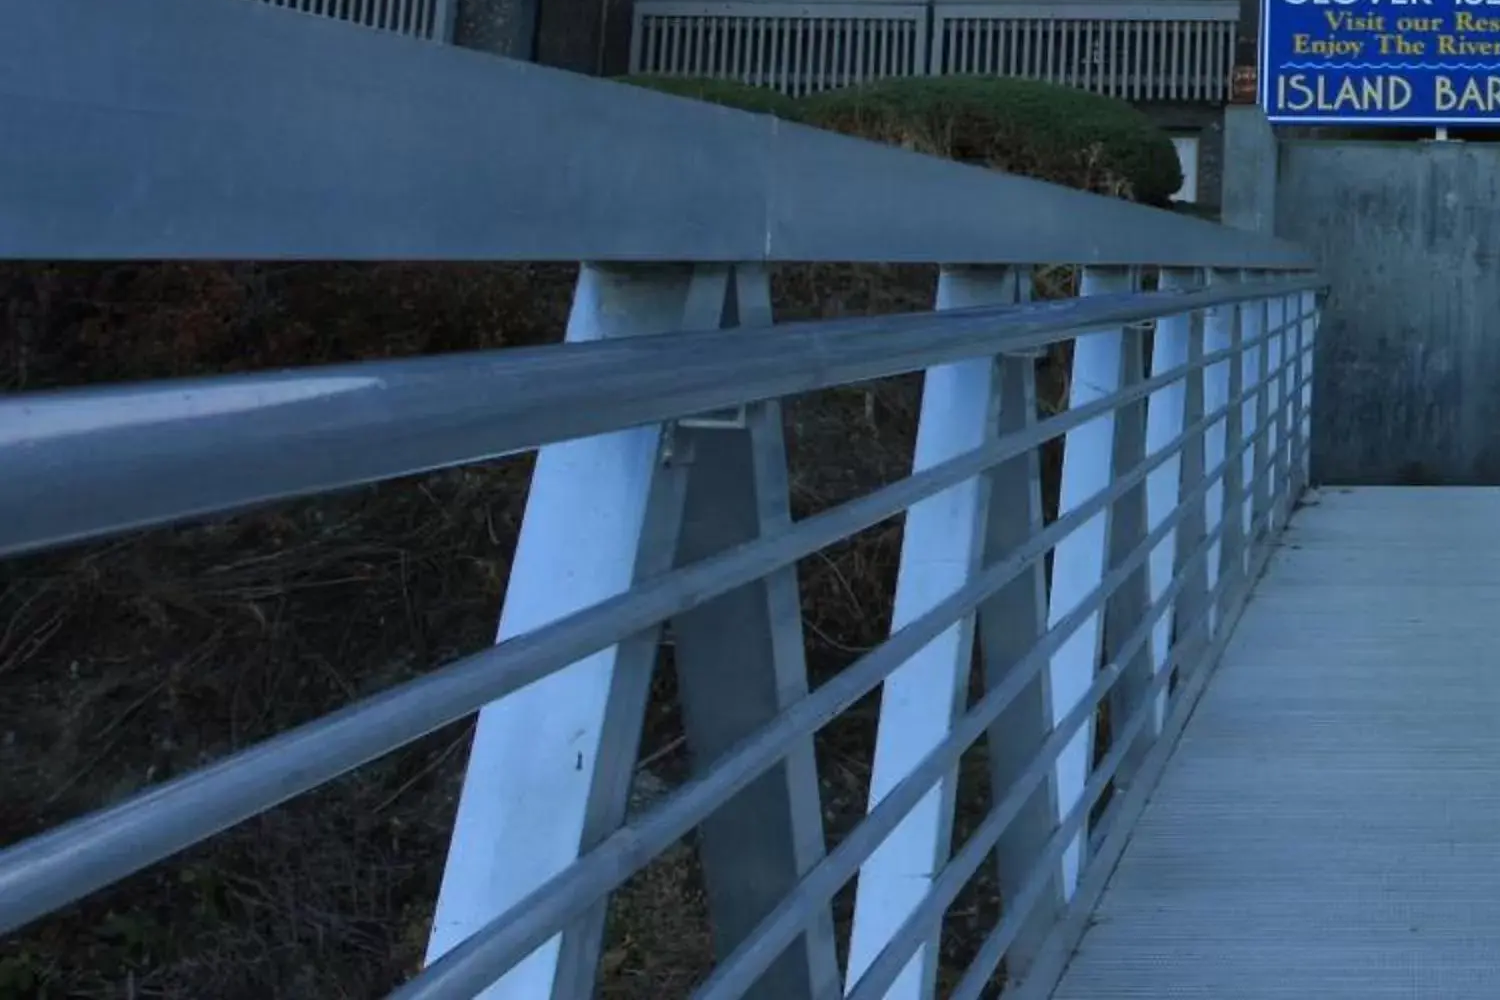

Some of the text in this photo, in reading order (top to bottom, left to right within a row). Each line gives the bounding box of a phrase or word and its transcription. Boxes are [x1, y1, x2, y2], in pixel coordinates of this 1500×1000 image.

[1324, 10, 1385, 32] Visit
[1396, 17, 1444, 32] our
[1293, 34, 1363, 60] Enjoy
[1375, 34, 1425, 55] The
[1277, 74, 1412, 111] ISLAND
